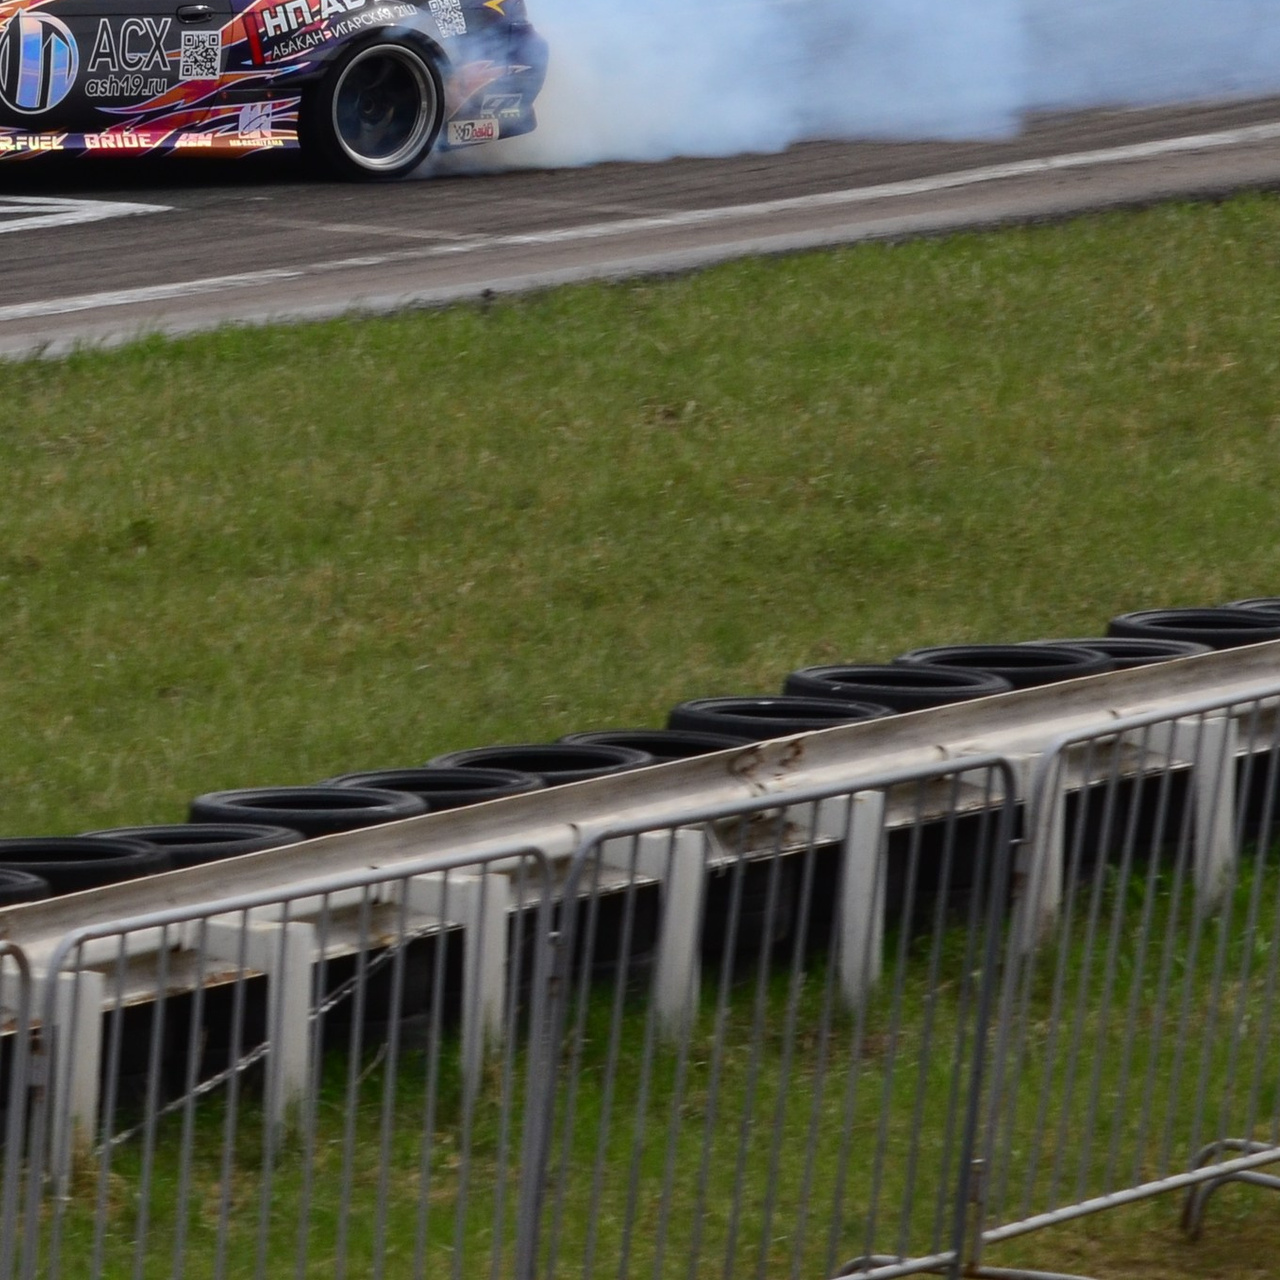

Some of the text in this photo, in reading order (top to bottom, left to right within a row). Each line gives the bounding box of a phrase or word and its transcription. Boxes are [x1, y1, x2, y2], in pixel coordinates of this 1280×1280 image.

[271, 30, 325, 61] АБАКАН
[85, 74, 167, 96] ash19.ru
[84, 133, 155, 149] BRIDE
